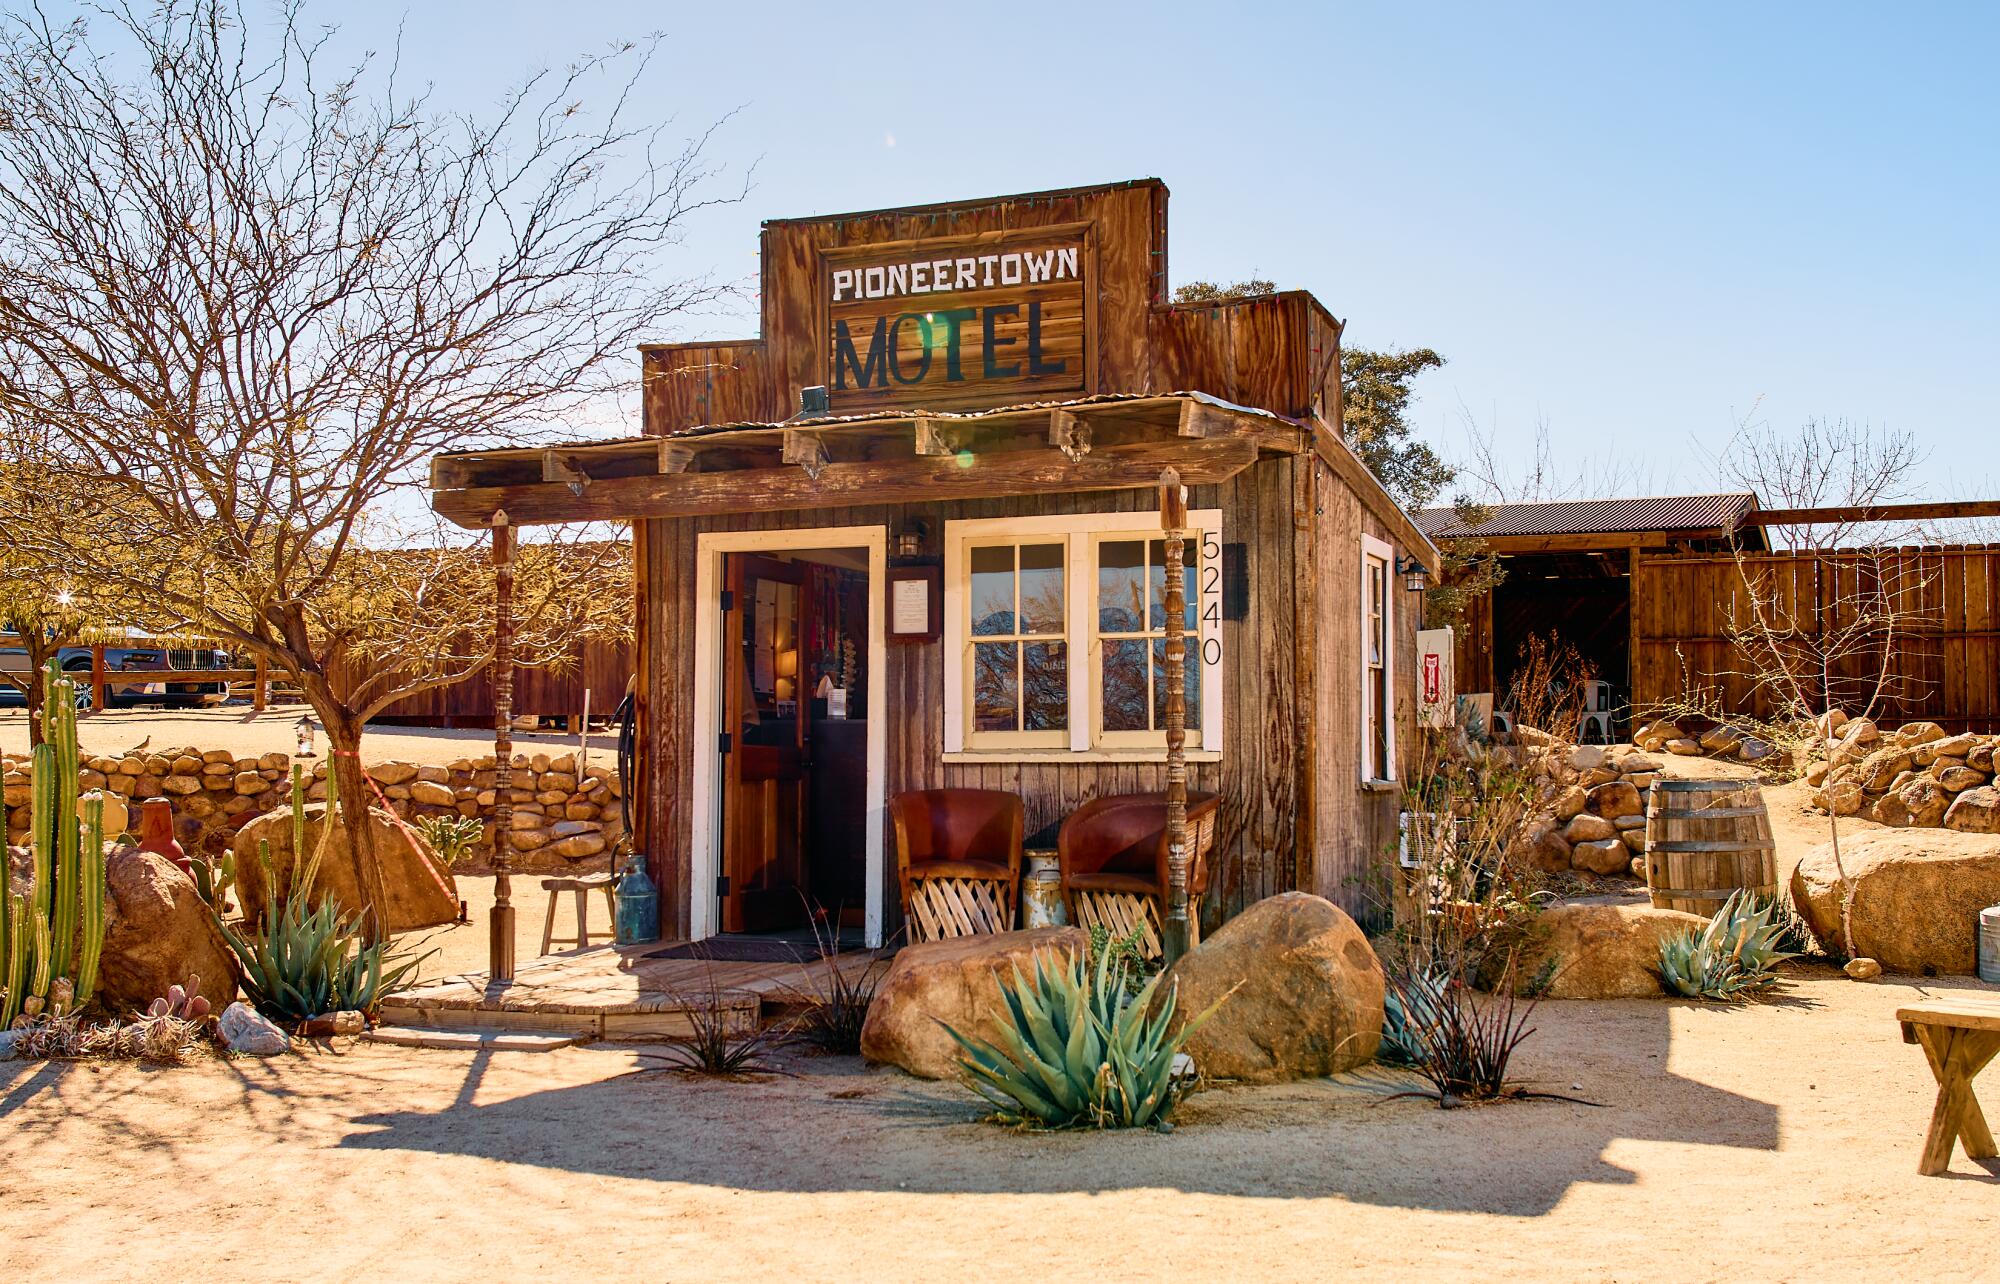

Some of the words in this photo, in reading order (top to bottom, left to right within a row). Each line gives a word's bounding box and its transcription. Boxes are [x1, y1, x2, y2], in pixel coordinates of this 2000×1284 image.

[833, 248, 1078, 300] PIONEERTOWN
[835, 302, 1066, 390] MOTEL
[1203, 532, 1221, 665] 5240
